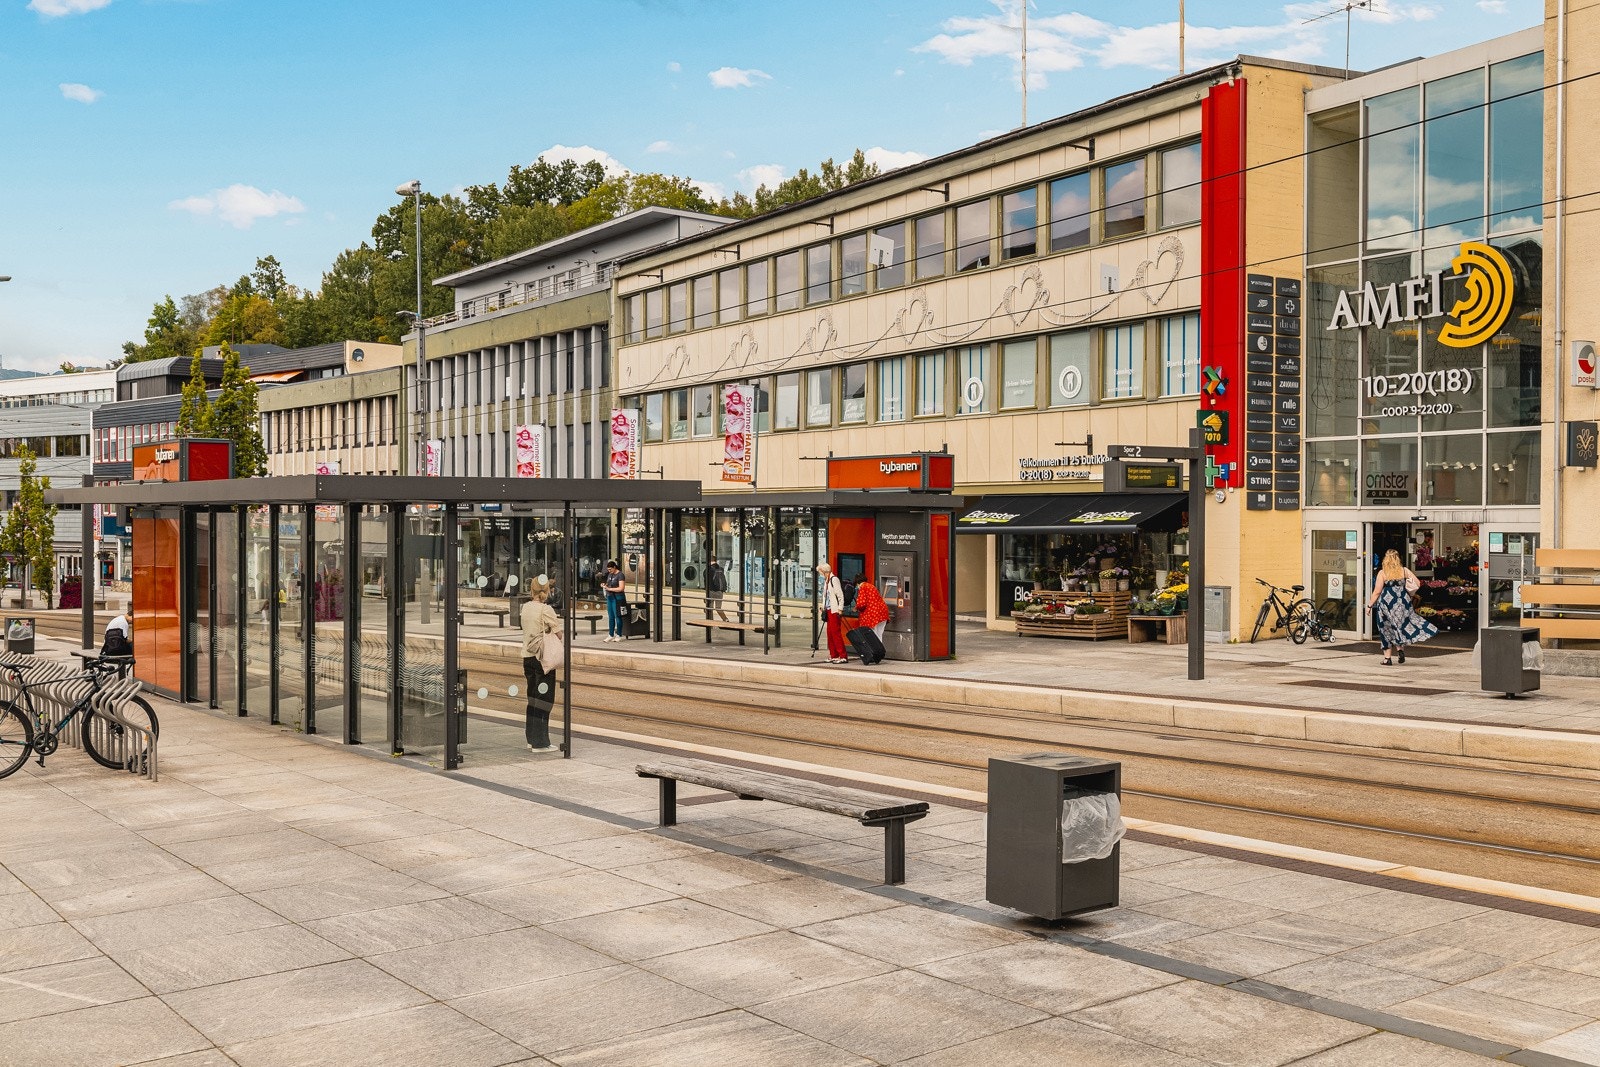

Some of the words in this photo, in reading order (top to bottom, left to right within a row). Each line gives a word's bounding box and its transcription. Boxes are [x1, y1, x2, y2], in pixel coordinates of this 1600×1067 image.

[1326, 269, 1444, 330] AMFI
[1365, 368, 1473, 398] 10-20(18)
[1282, 399, 1297, 409] nille
[1381, 406, 1409, 417] COOP
[1410, 402, 1454, 416] 9-22(20)
[745, 396, 753, 433] Sommer
[1282, 418, 1297, 426] VIC
[155, 448, 175, 464] bybanen
[743, 433, 752, 473] HANDEL
[1123, 446, 1135, 454] Spor
[1135, 446, 1142, 457] 2
[879, 461, 918, 474] bybanen
[1019, 458, 1060, 469] Velkommen
[1060, 457, 1069, 466] til
[1071, 456, 1081, 465] 25
[1081, 454, 1113, 465] butikker
[1250, 476, 1272, 485] STING
